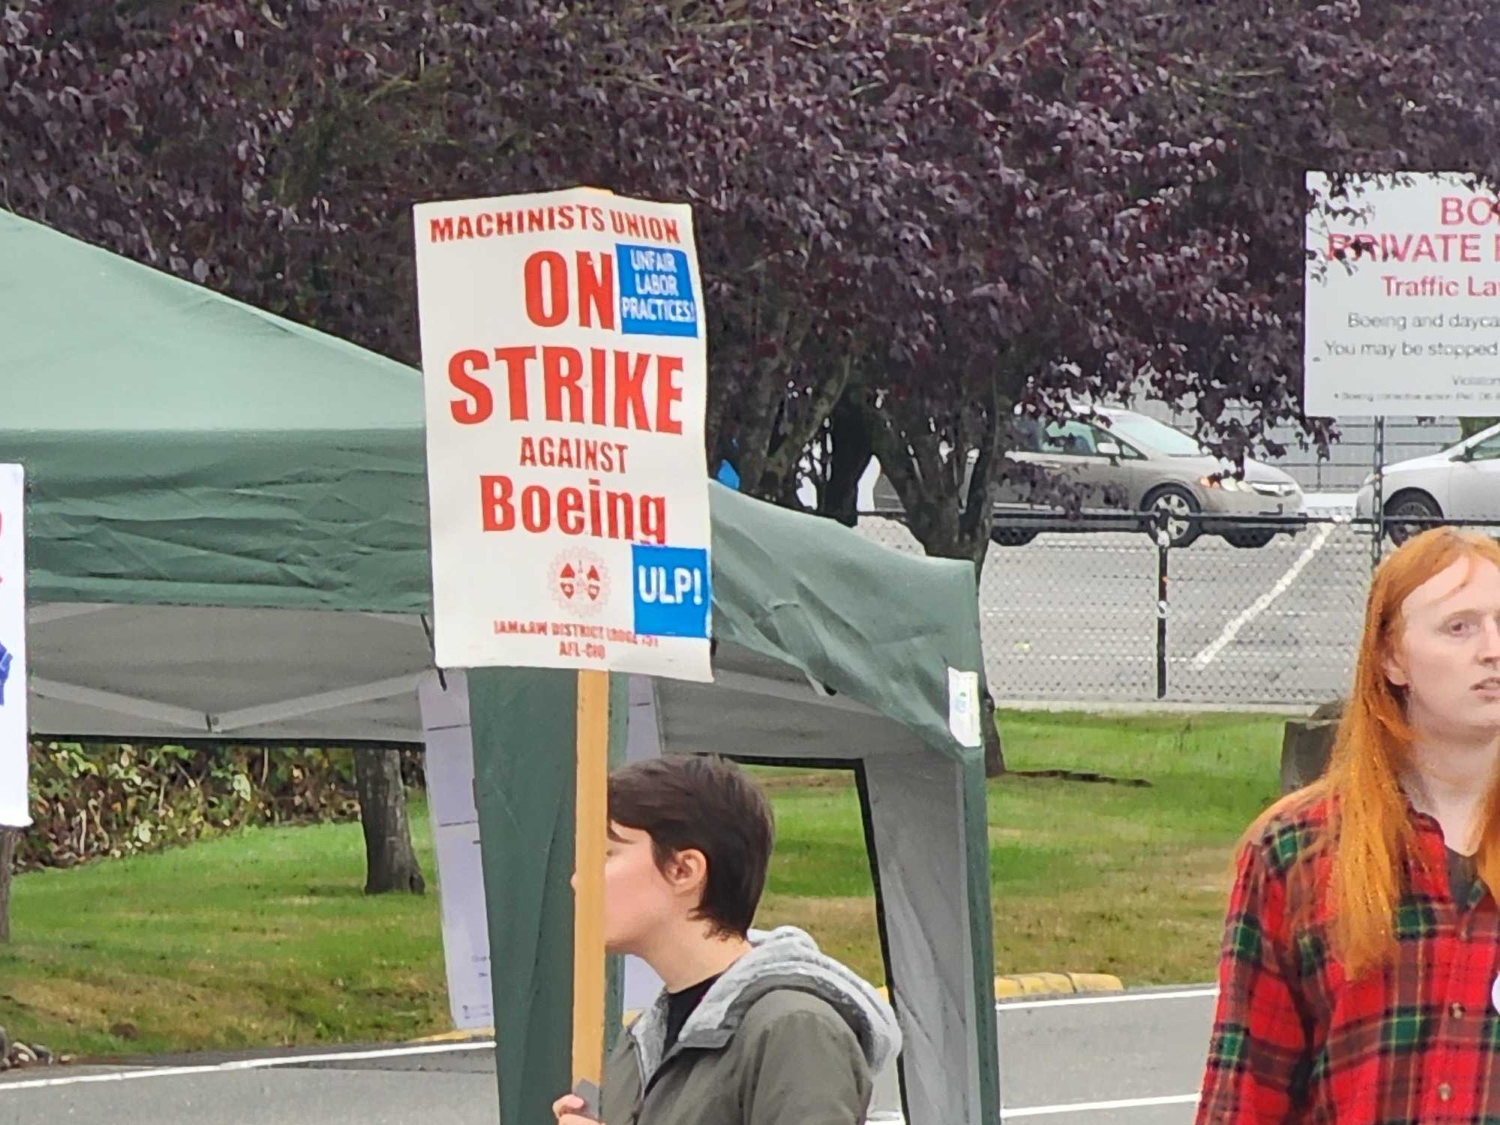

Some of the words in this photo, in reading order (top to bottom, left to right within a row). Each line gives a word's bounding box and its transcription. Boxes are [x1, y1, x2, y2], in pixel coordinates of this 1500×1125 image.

[430, 205, 604, 243] MACHINISTS
[610, 208, 680, 244] UNION
[1441, 197, 1500, 225] BO
[630, 248, 678, 274] UNFAIR
[524, 250, 615, 331] ON
[635, 273, 679, 297] LABOR
[1381, 275, 1459, 297] Traffic
[1467, 276, 1500, 297] La
[621, 296, 695, 323] PRACTICES!
[1348, 313, 1407, 331] Boeing
[1412, 313, 1444, 328] and
[1324, 341, 1356, 356] You
[1361, 343, 1397, 359] may
[1402, 342, 1423, 356] be
[1428, 341, 1498, 358] stopped
[448, 344, 684, 435] STRIKE
[520, 436, 628, 474] AGAINST
[480, 474, 666, 545] Boeing
[638, 564, 703, 606] ULP!
